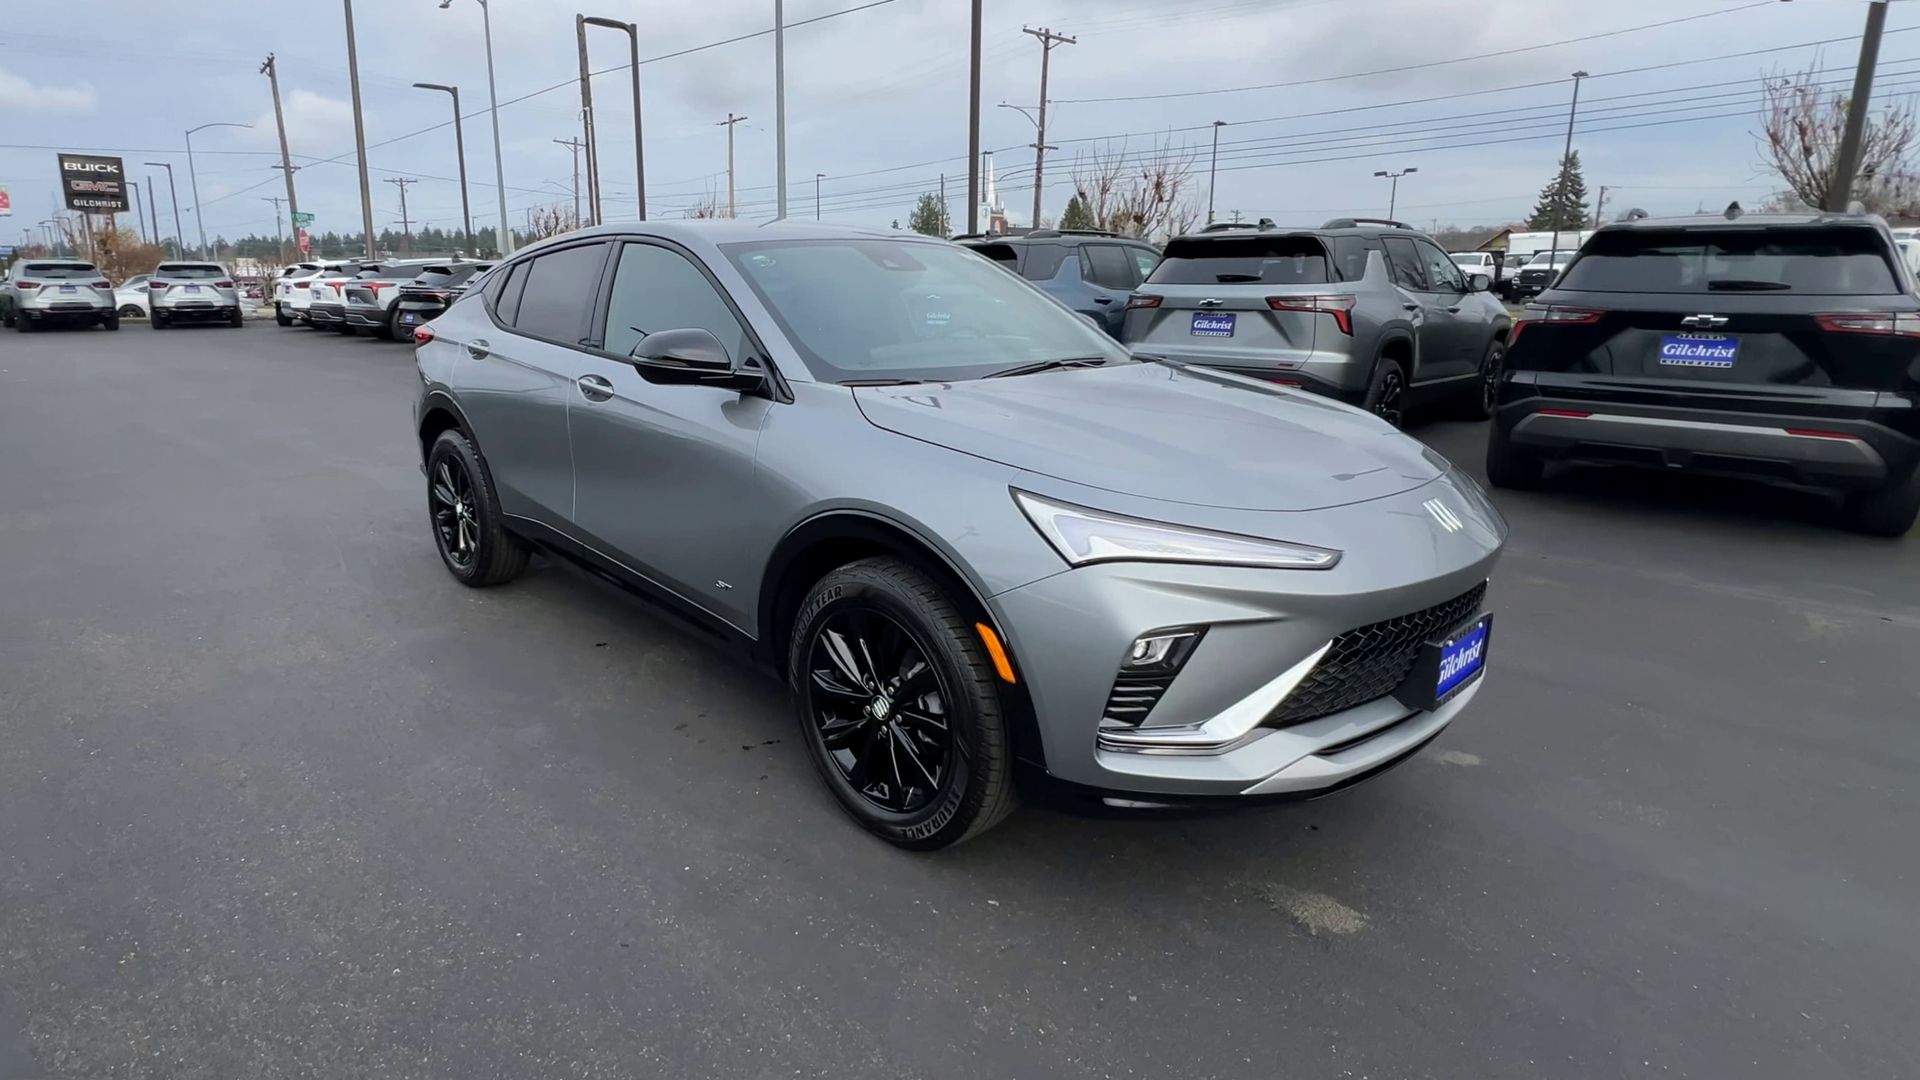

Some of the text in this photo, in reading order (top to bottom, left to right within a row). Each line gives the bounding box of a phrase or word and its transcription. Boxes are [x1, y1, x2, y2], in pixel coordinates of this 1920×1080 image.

[63, 162, 119, 173] BUICK
[70, 180, 119, 192] GMC
[73, 199, 122, 208] GILCHRIST
[1193, 319, 1232, 330] Gilchrist
[1662, 343, 1735, 358] Gilchrist
[1437, 638, 1482, 685] Gilchrist
